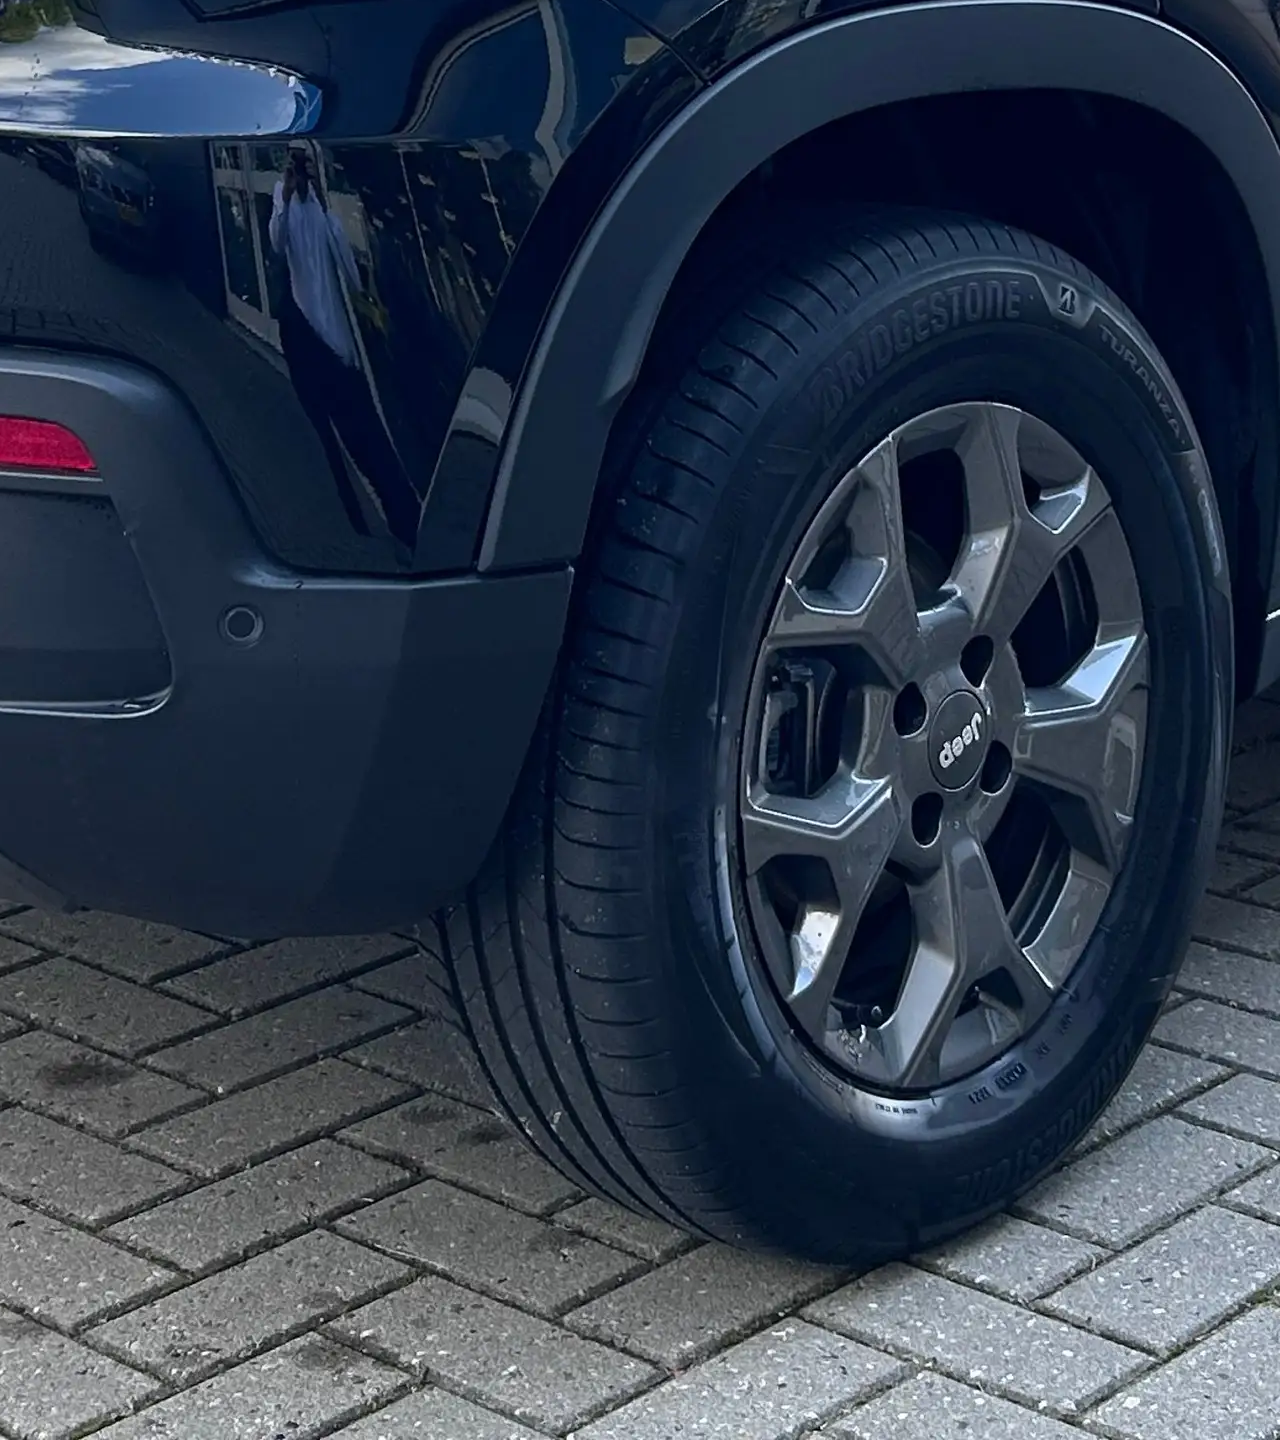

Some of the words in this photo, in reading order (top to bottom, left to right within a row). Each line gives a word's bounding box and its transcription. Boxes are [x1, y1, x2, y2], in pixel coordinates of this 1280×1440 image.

[808, 278, 1022, 428] BRIDGESTONE
[1097, 321, 1181, 441] TURANZA
[938, 712, 983, 769] Jeep
